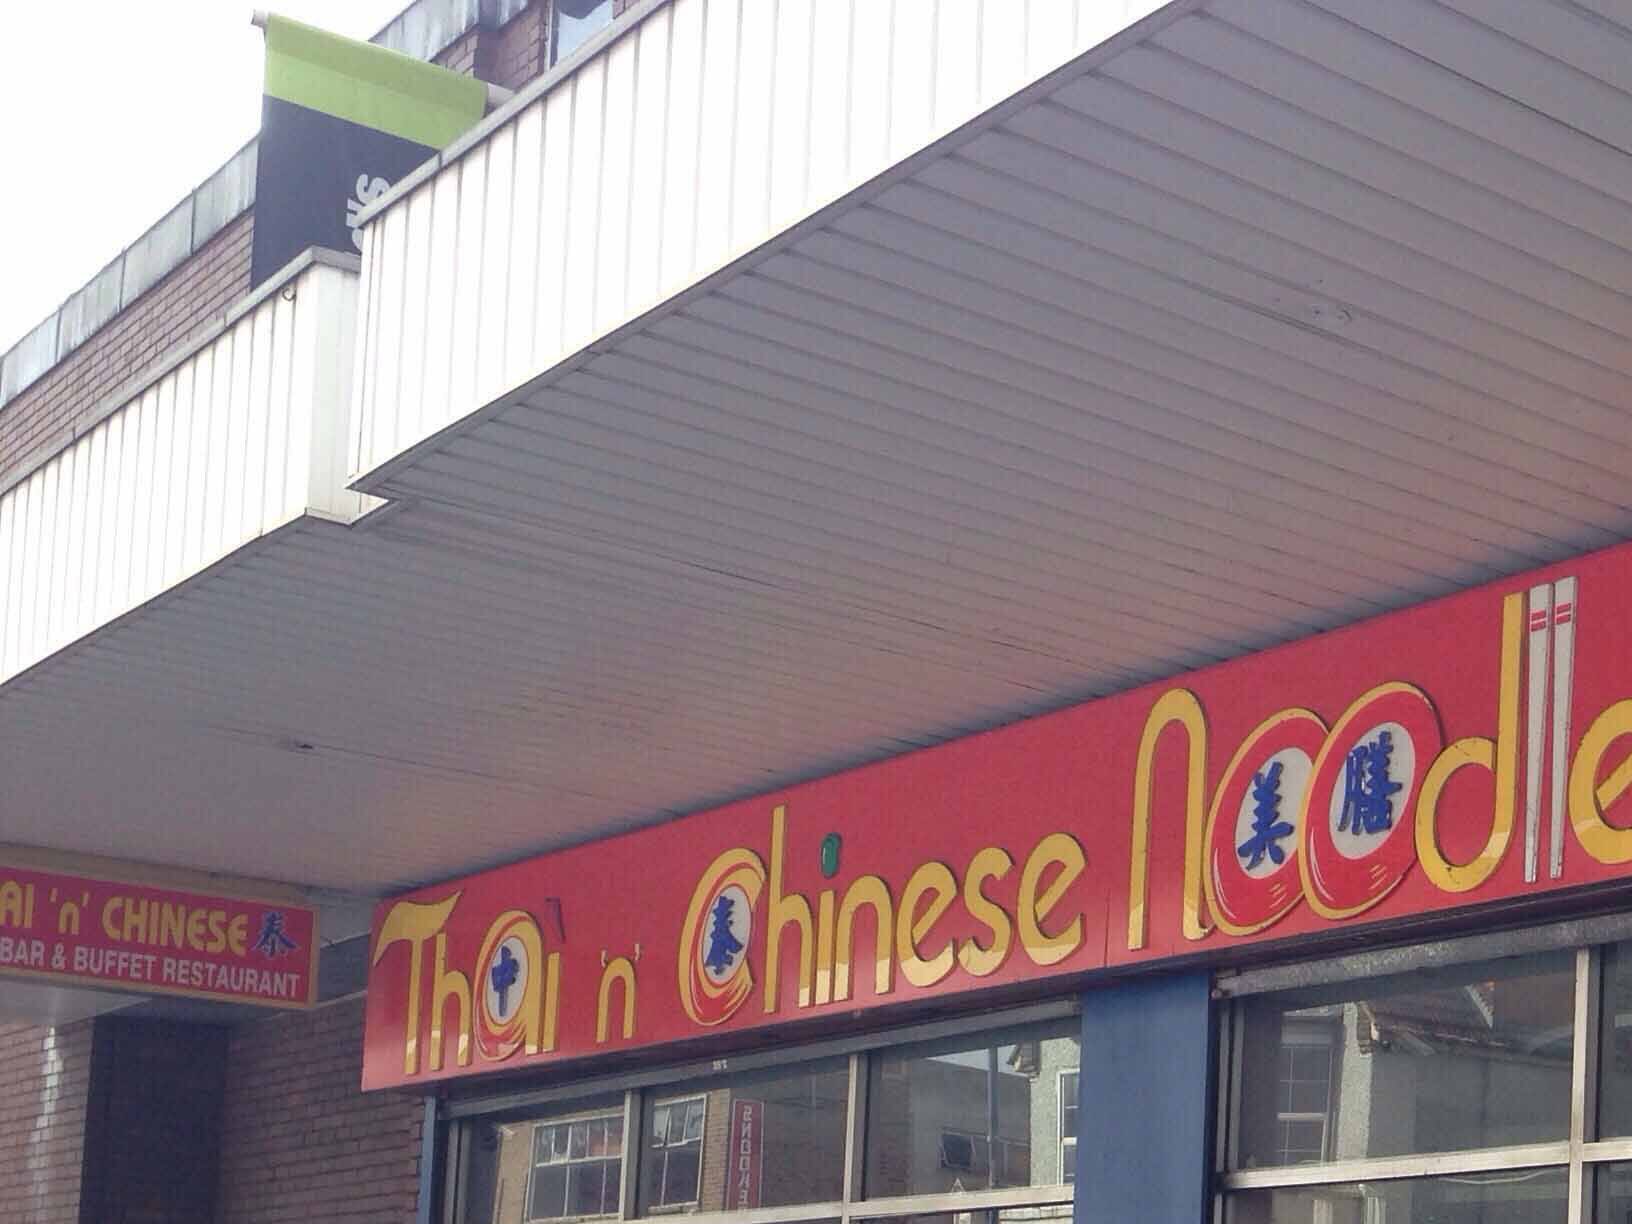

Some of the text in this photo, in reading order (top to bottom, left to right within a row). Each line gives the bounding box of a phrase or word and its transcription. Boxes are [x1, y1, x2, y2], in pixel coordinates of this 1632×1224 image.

[1238, 761, 1294, 870] 美
[0, 937, 300, 998] BAR & BUFFET RESTAURANT
[102, 897, 249, 957] CHINESE
[373, 890, 562, 1075] Thai
[679, 803, 1087, 1026] Chinese
